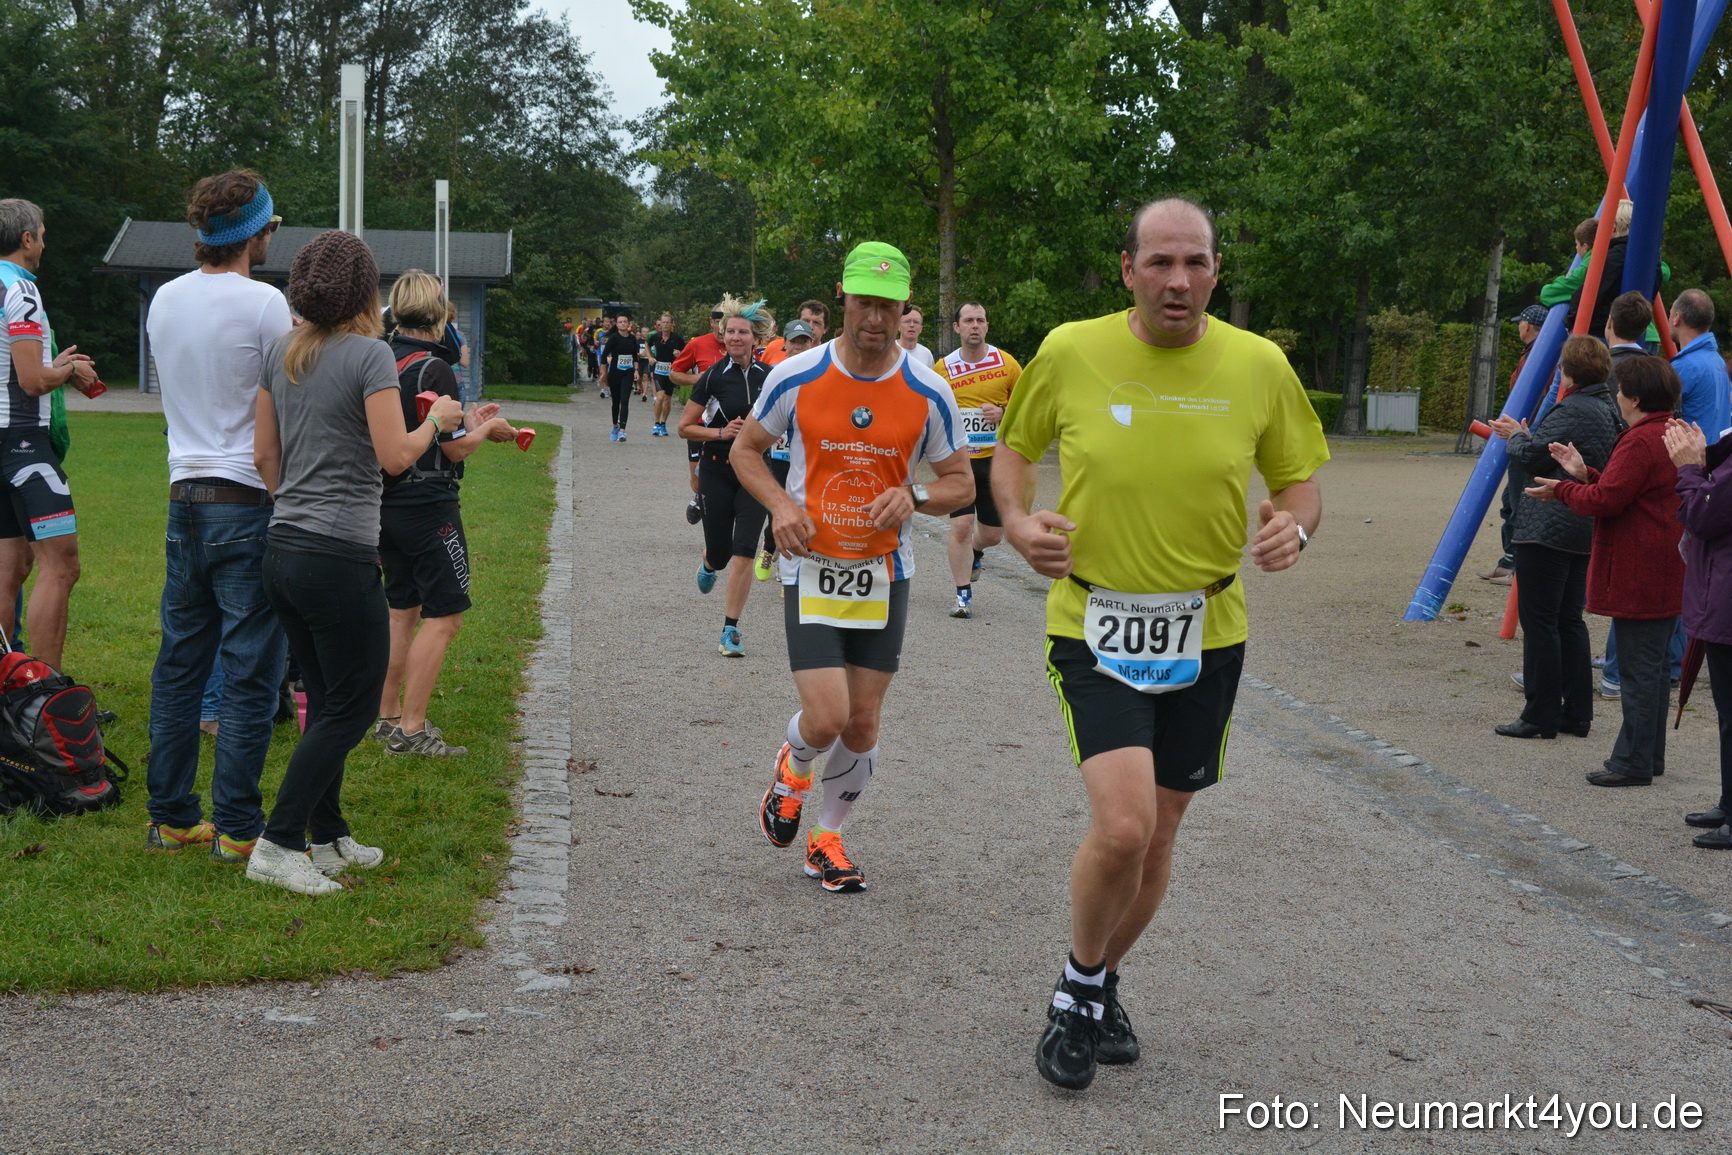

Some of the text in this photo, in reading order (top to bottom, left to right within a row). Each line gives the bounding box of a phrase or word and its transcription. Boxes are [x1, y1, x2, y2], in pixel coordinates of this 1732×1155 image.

[951, 370, 1008, 390] MAX BÖGL
[1199, 397, 1230, 405] Landkreises
[820, 440, 899, 457] SportScheck
[826, 502, 838, 511] 17.
[848, 495, 866, 504] 2012
[834, 559, 874, 571] Neumarkt
[818, 567, 873, 597] 629
[1089, 597, 1187, 613] PARTL Neumarkt
[1097, 614, 1193, 654] 2097
[1118, 664, 1172, 681] Markus
